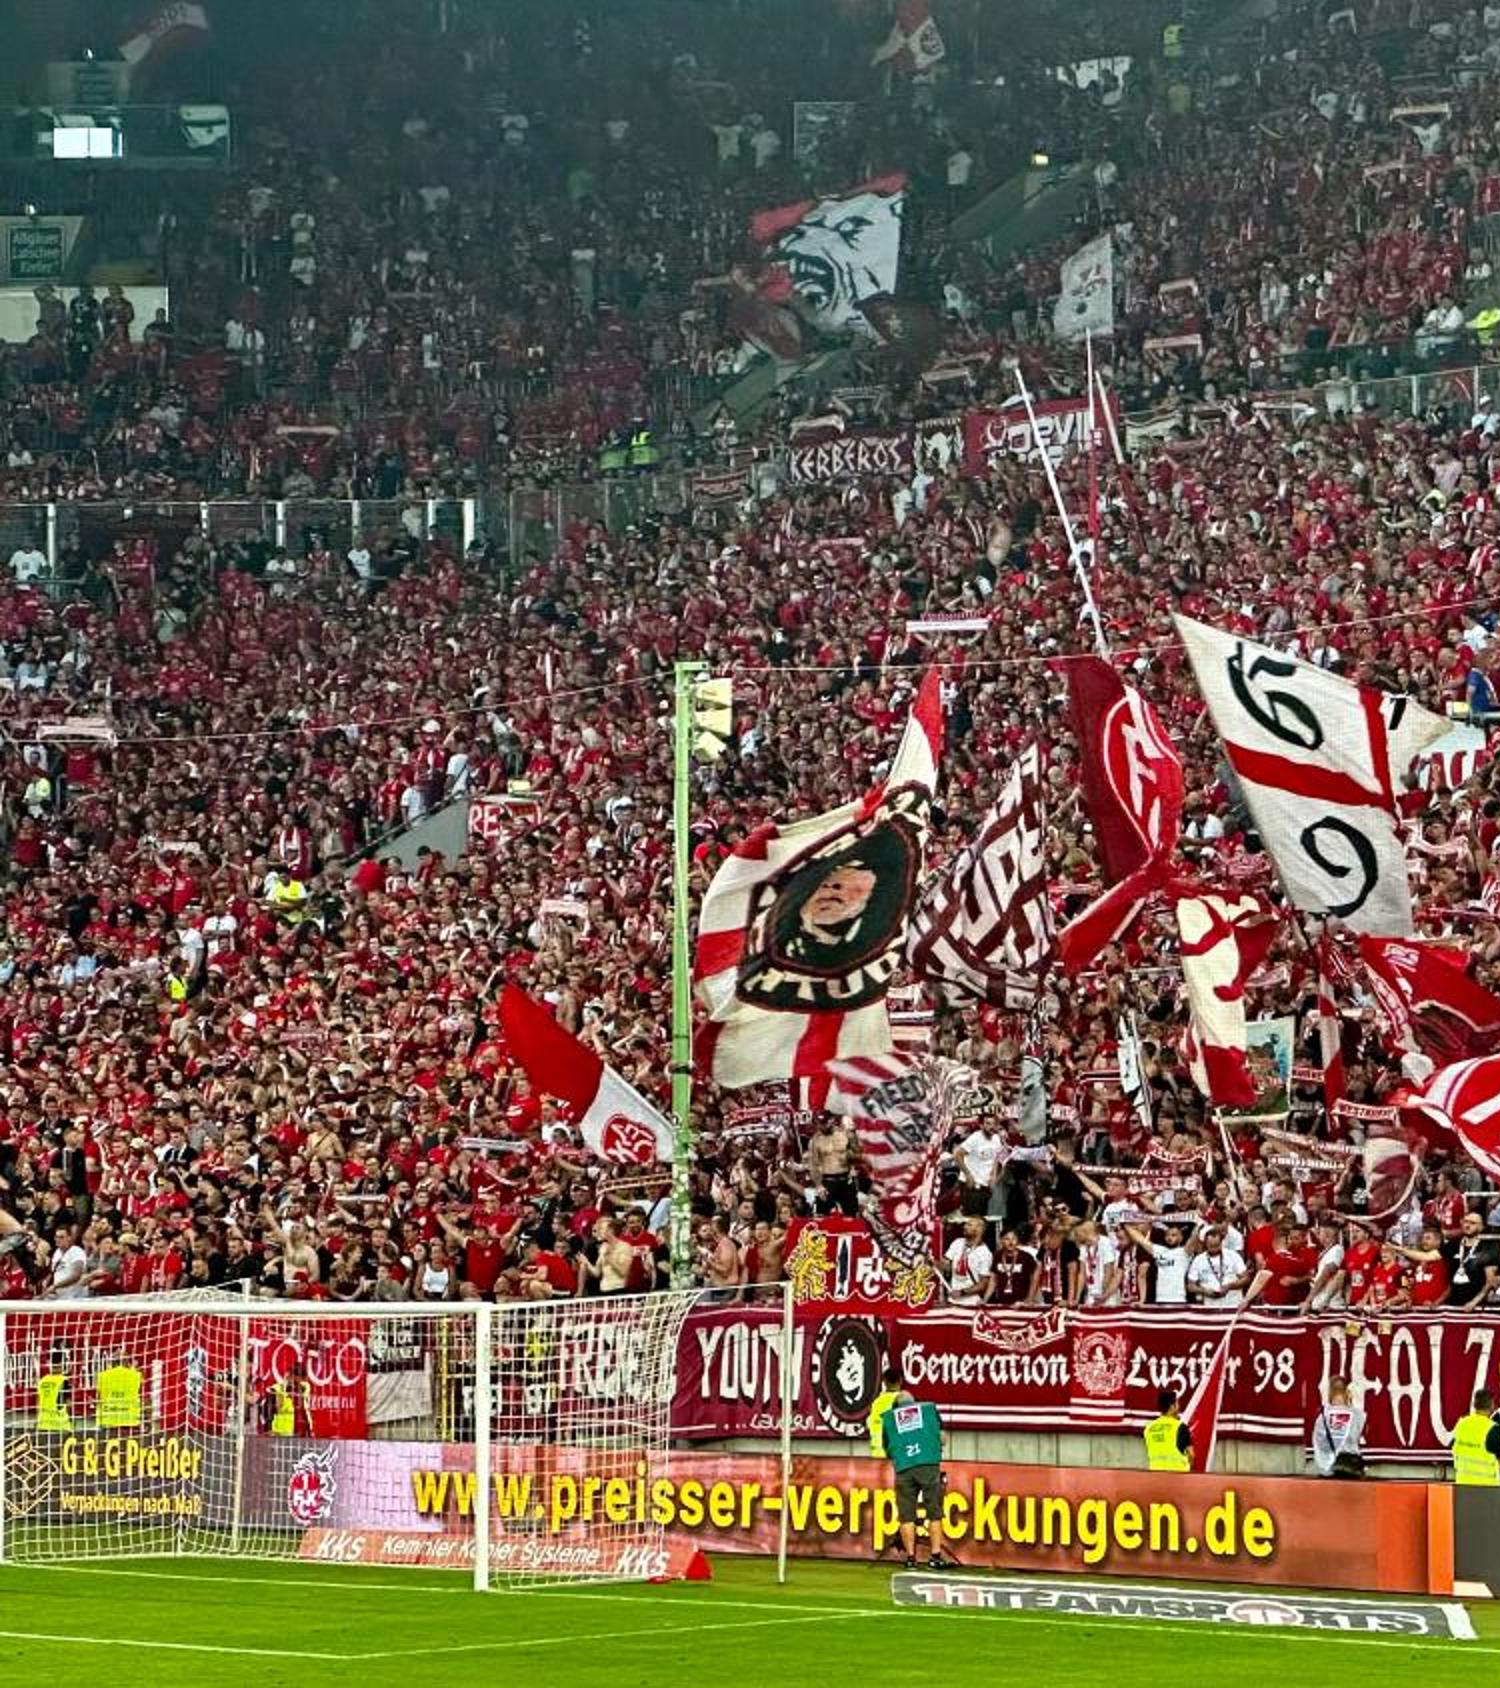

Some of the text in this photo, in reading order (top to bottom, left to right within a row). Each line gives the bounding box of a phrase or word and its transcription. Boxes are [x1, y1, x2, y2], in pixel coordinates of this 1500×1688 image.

[789, 440, 901, 484] KERBEROS
[695, 1321, 806, 1404] YOUTH
[901, 1340, 1071, 1388] Generation
[1126, 1341, 1242, 1396] Luzifr
[63, 1437, 201, 1480] G & G Preißer
[412, 1461, 1275, 1566] www.preisser-verpckungen.de
